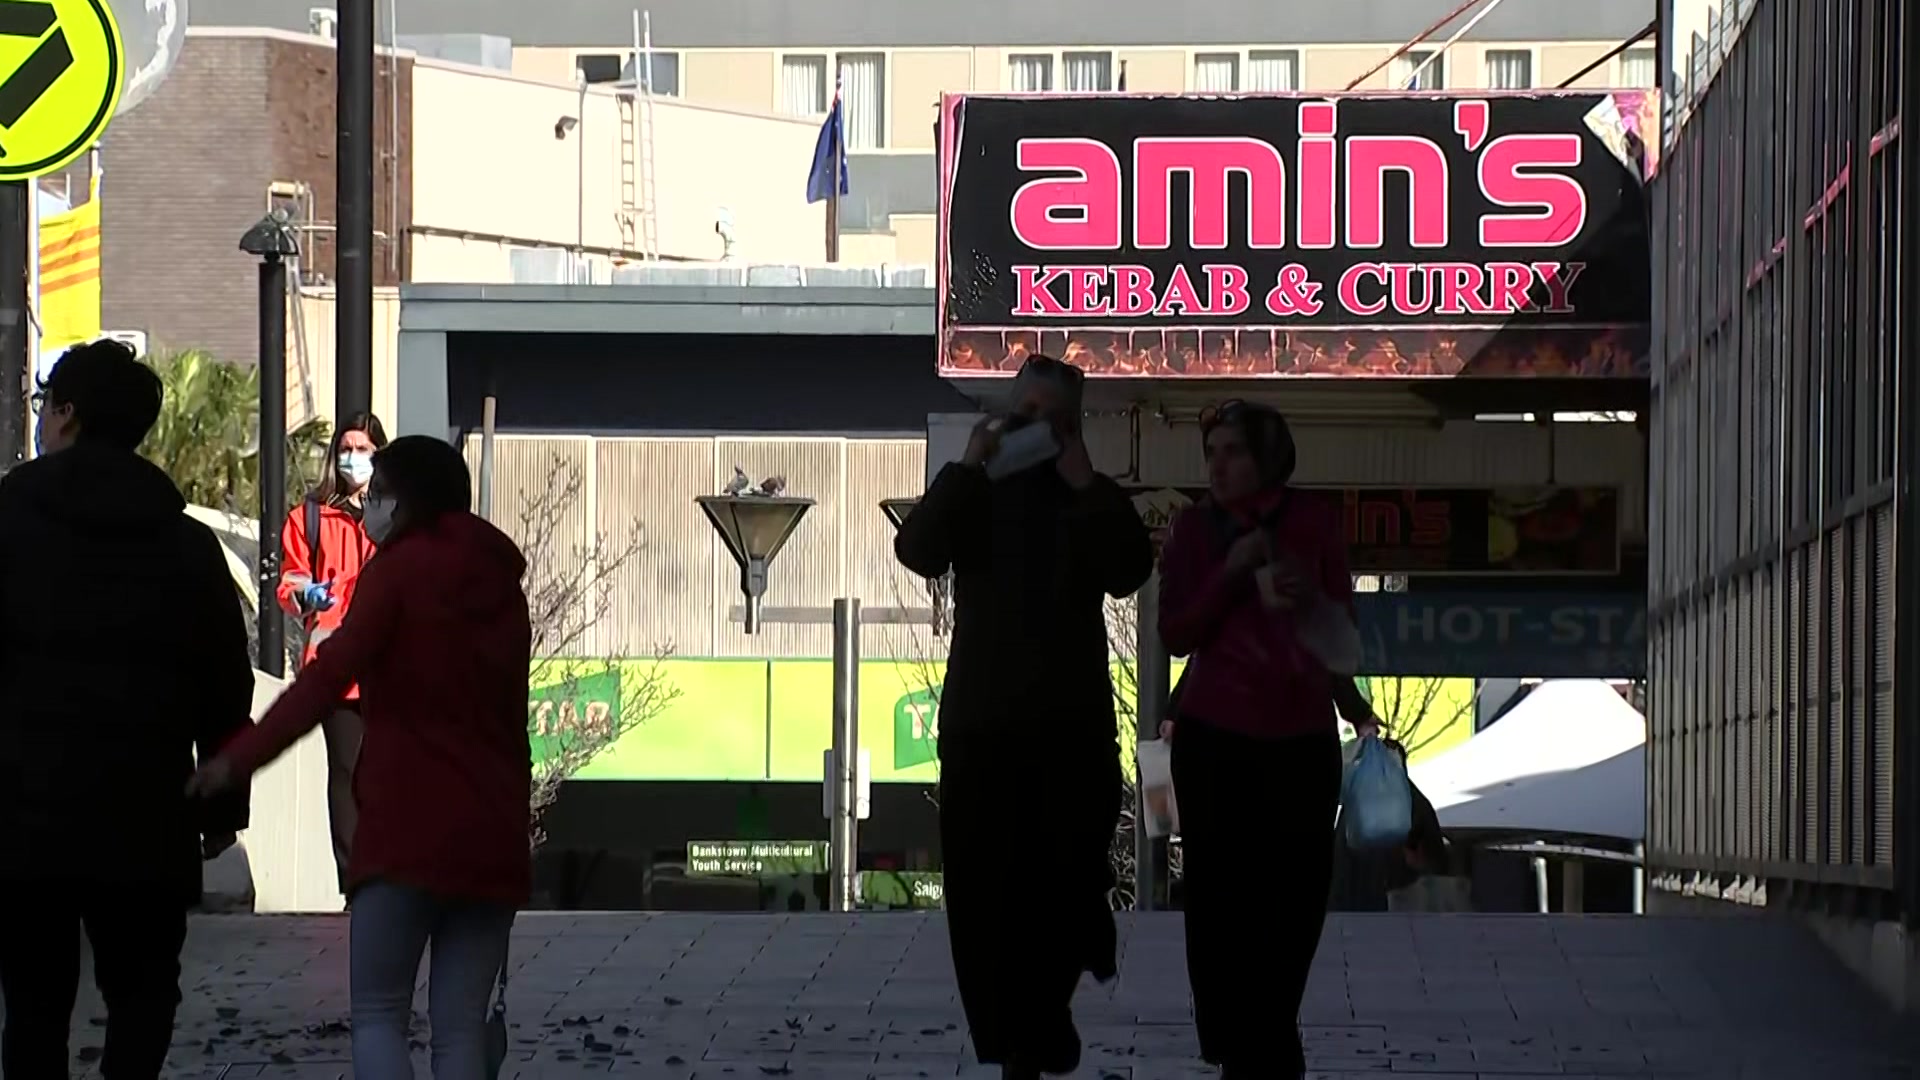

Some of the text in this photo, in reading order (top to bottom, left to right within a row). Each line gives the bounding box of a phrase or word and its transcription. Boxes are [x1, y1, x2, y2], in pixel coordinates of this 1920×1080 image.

[1011, 101, 1587, 248] amin's
[1011, 262, 1587, 317] KEBAB & CURRY
[692, 845, 813, 857] Bankstown Multicultural
[692, 859, 762, 872] Youth Service
